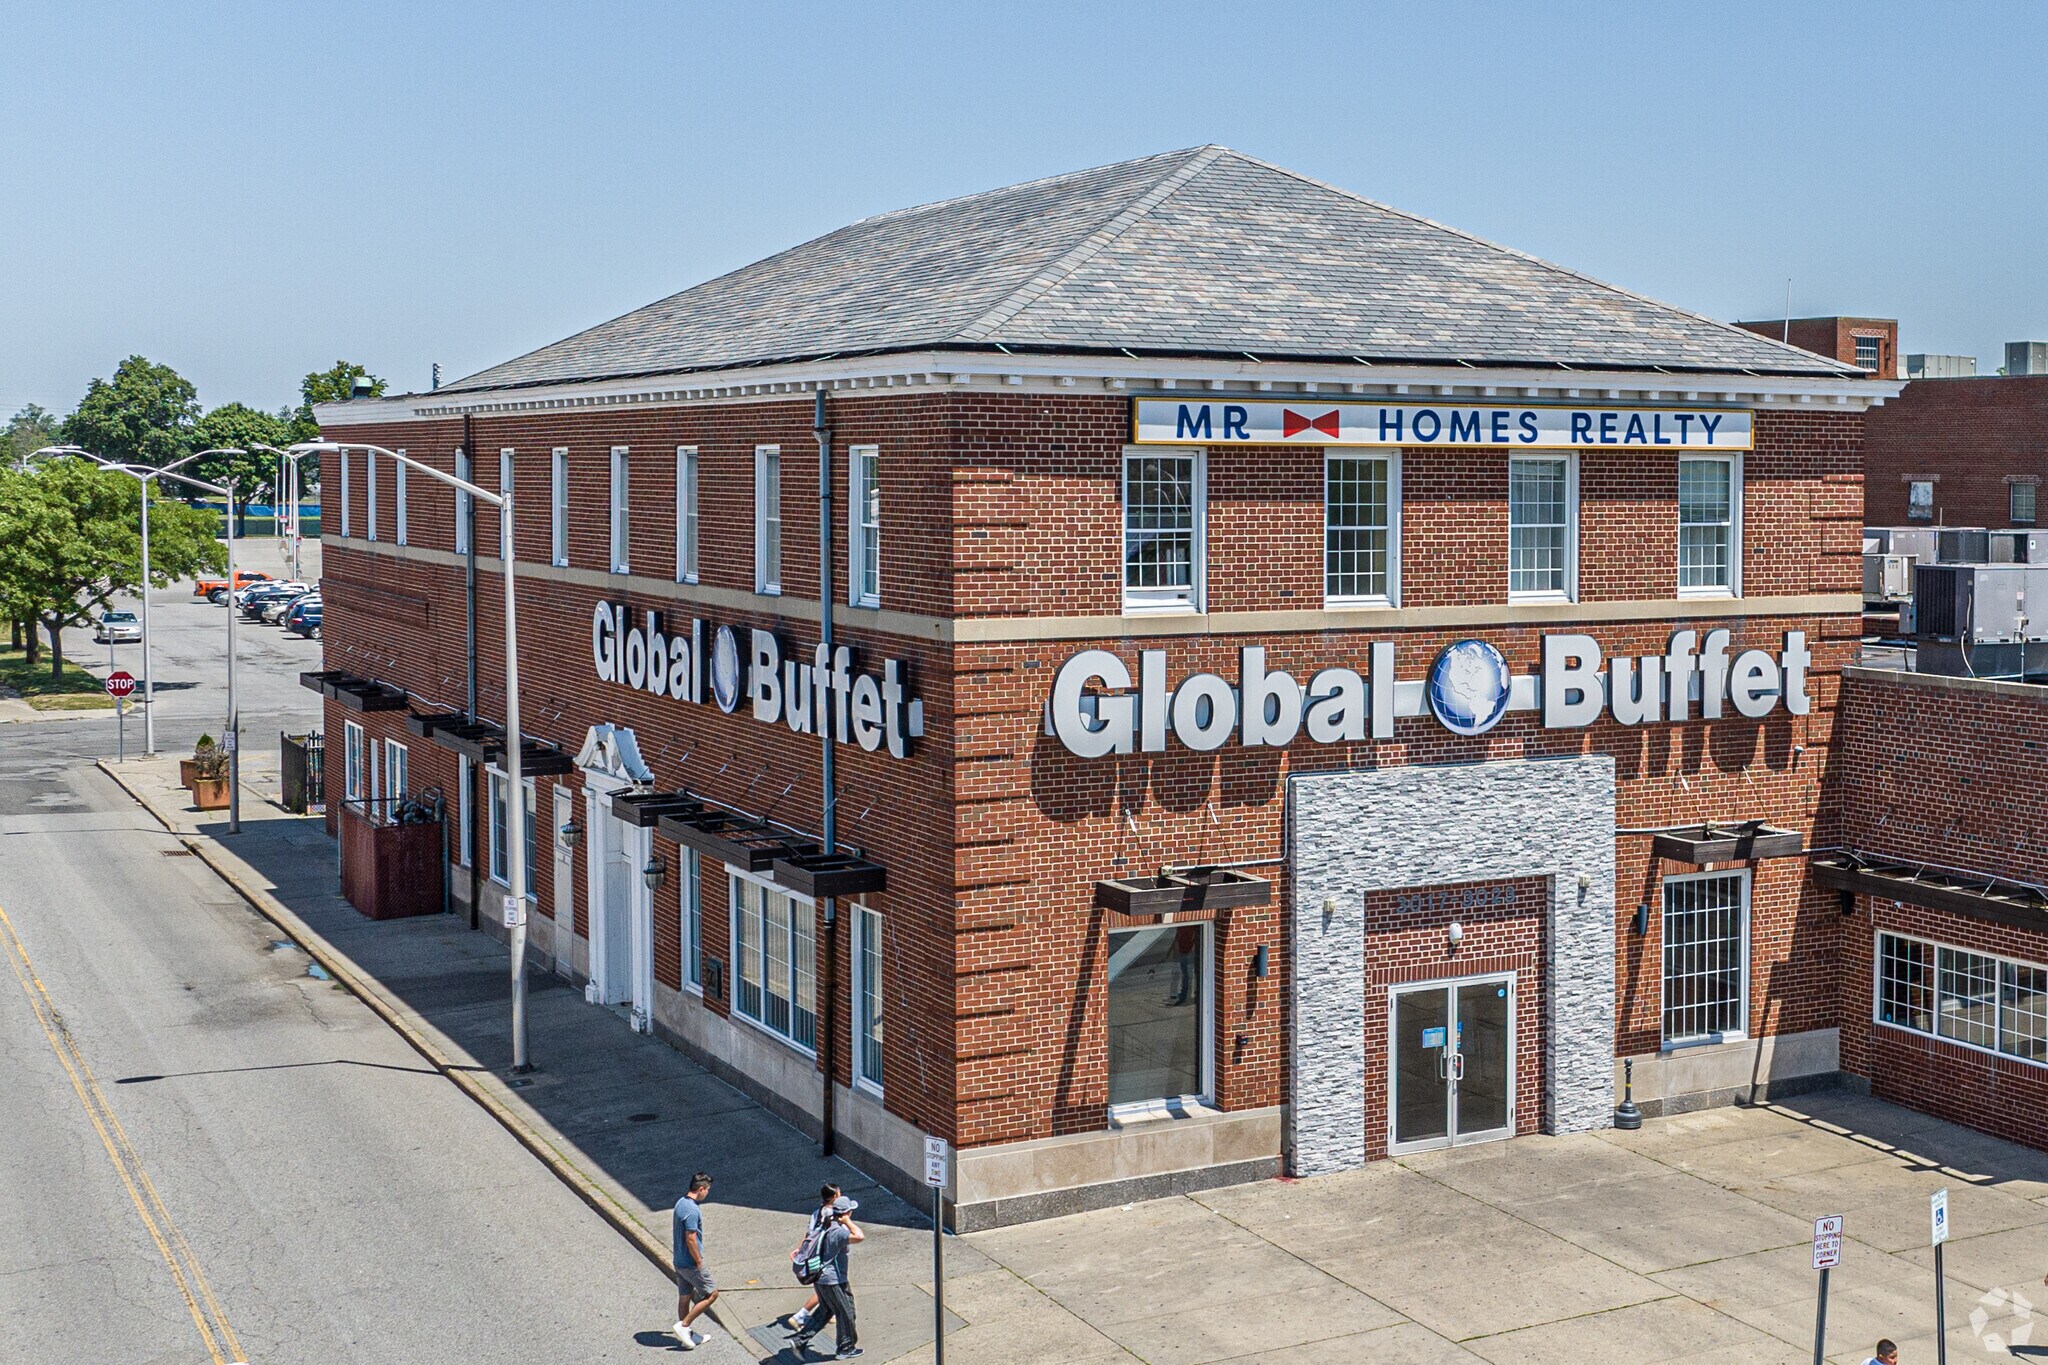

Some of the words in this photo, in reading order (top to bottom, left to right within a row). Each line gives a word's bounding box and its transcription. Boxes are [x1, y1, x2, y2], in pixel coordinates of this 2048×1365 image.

[1175, 404, 1250, 441] MR
[1378, 407, 1538, 444] HOMES
[1570, 411, 1723, 446] REALTY
[108, 679, 134, 690] STOP
[592, 599, 710, 705] Global
[751, 628, 914, 759] Buffet
[1051, 641, 1395, 758] Global
[1540, 629, 1811, 728] Buffet
[1396, 886, 1516, 914] 3017-3023
[931, 1142, 941, 1153] NO
[1823, 1221, 1834, 1232] NO
[1815, 1232, 1841, 1242] STOPPING
[1832, 1240, 1839, 1248] TO
[1815, 1249, 1838, 1259] CORNER
